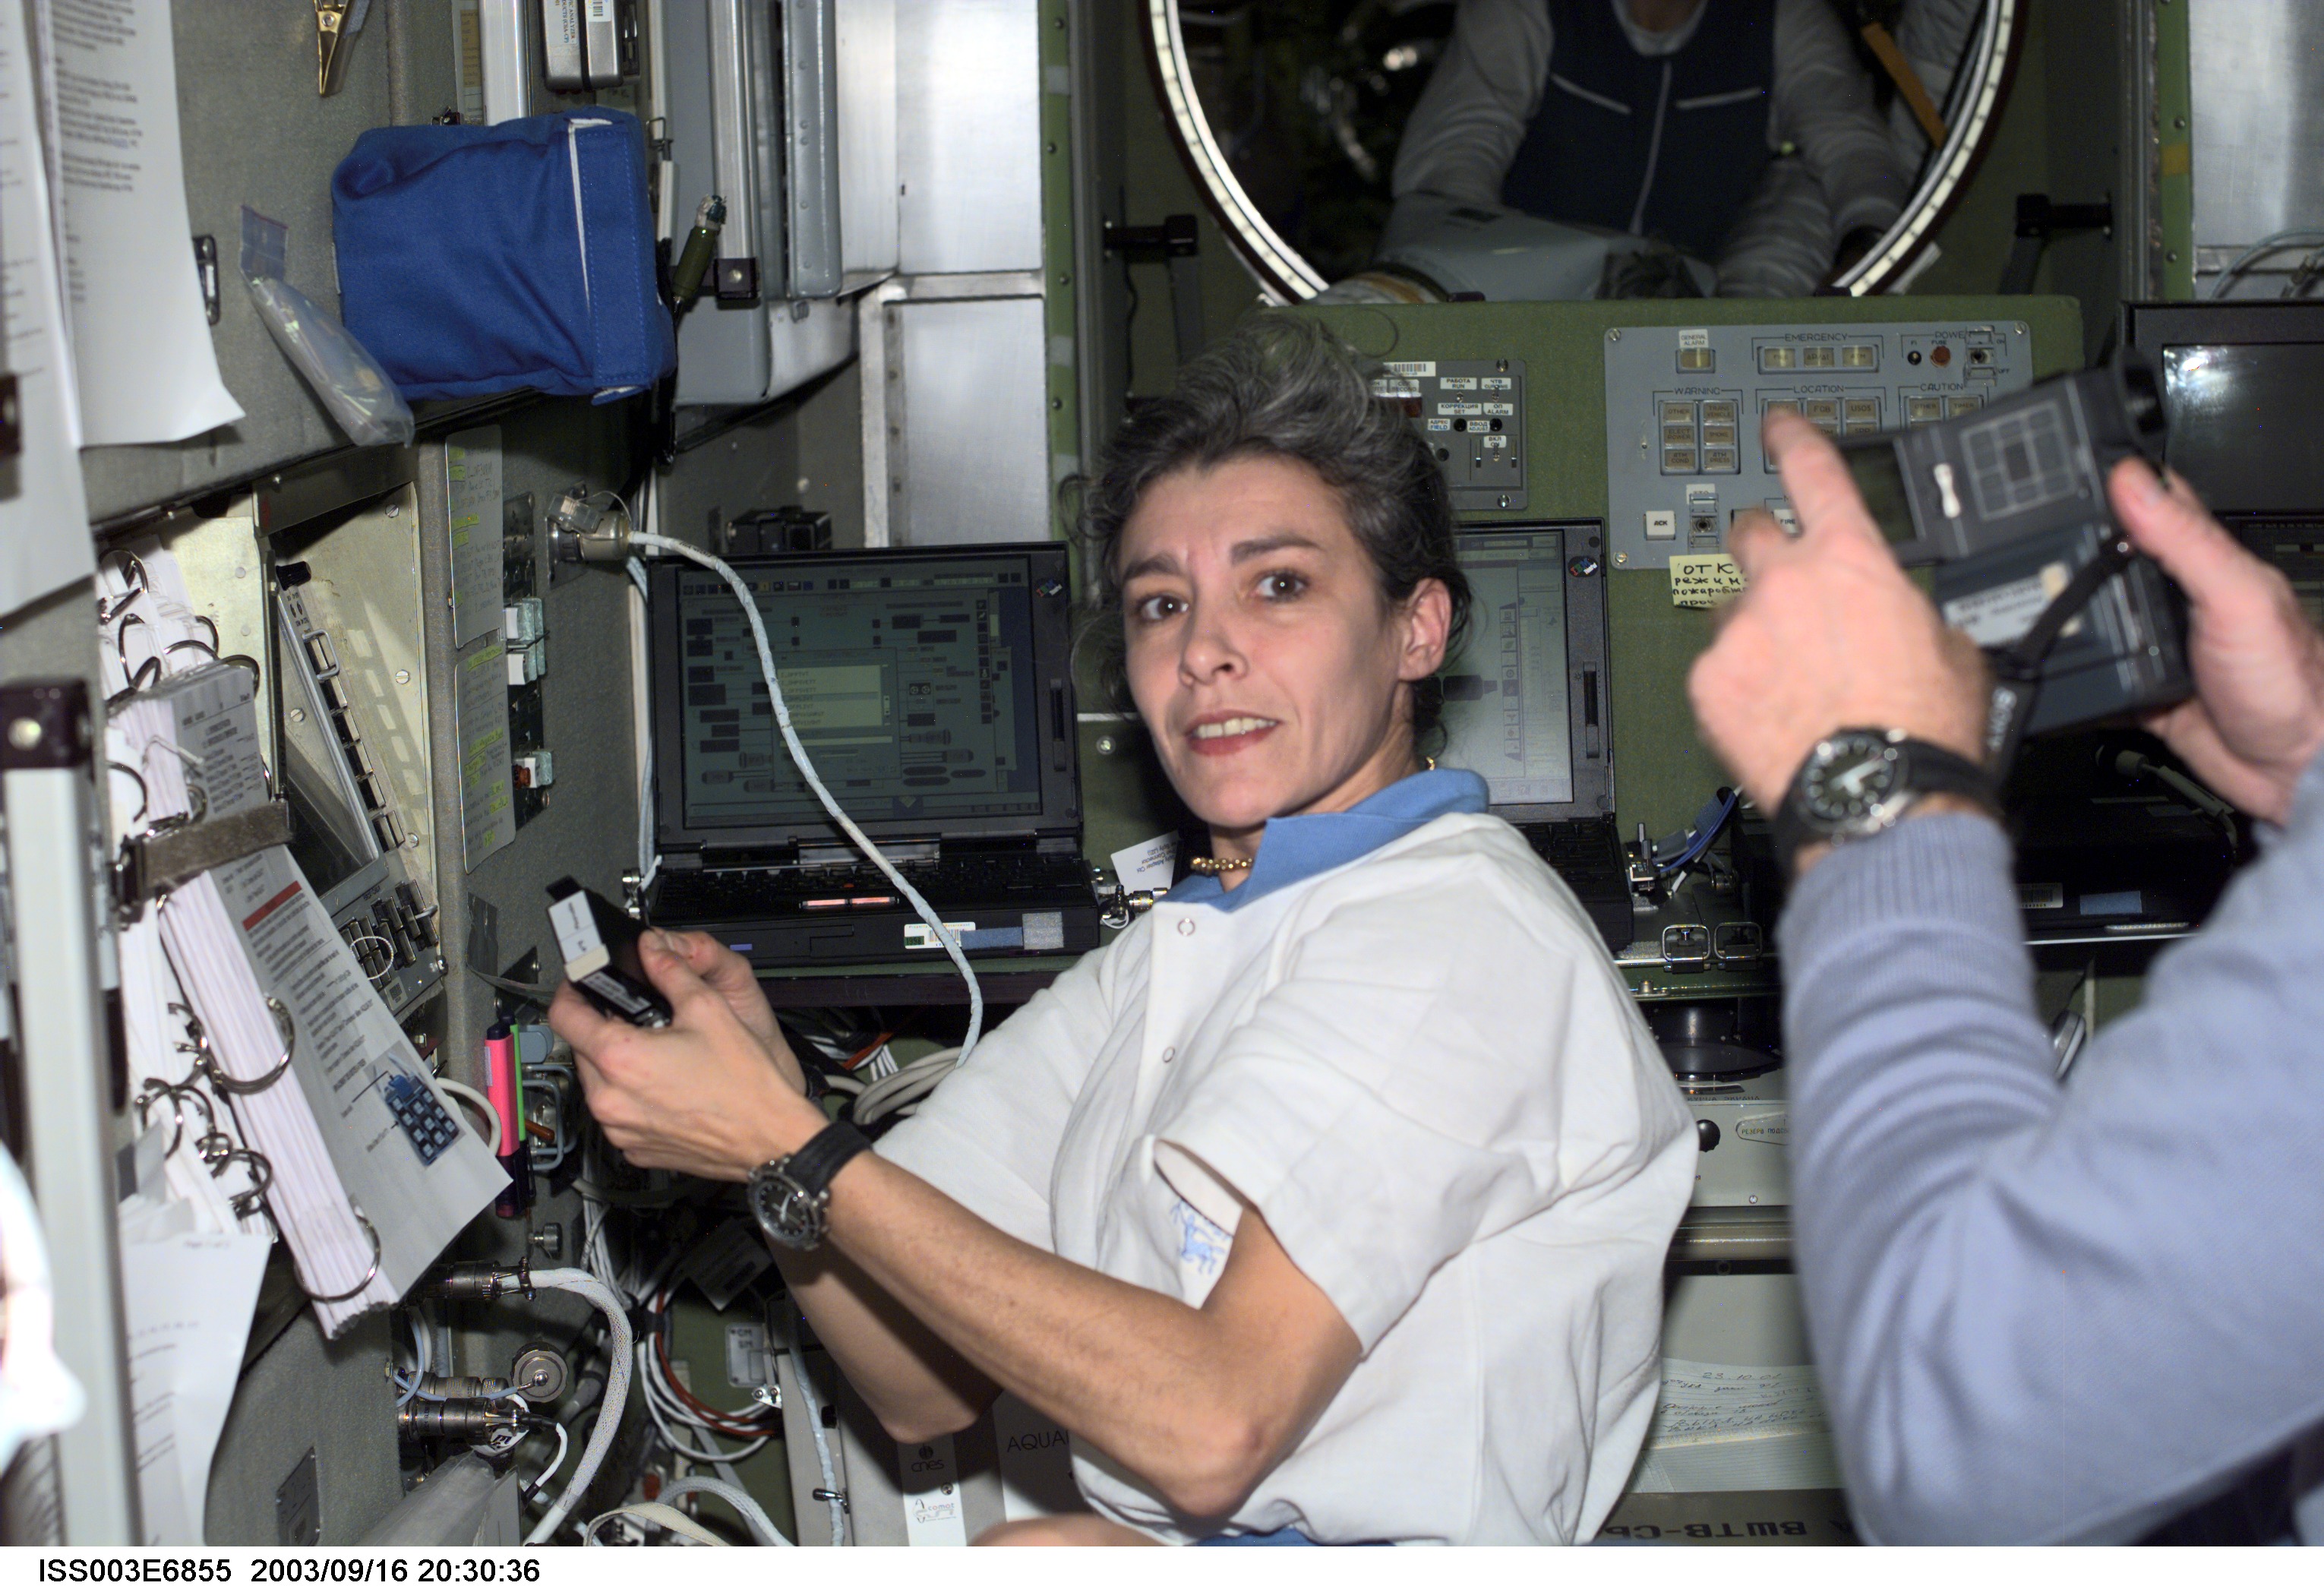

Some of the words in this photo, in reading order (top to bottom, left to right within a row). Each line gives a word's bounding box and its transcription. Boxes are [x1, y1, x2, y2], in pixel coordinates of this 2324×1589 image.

[1785, 333, 1848, 341] EMERGENCY
[1934, 330, 1966, 339] POWE
[1793, 385, 1844, 393] LOCATION
[1683, 563, 1742, 575] ОТК
[911, 1459, 945, 1472] cnes
